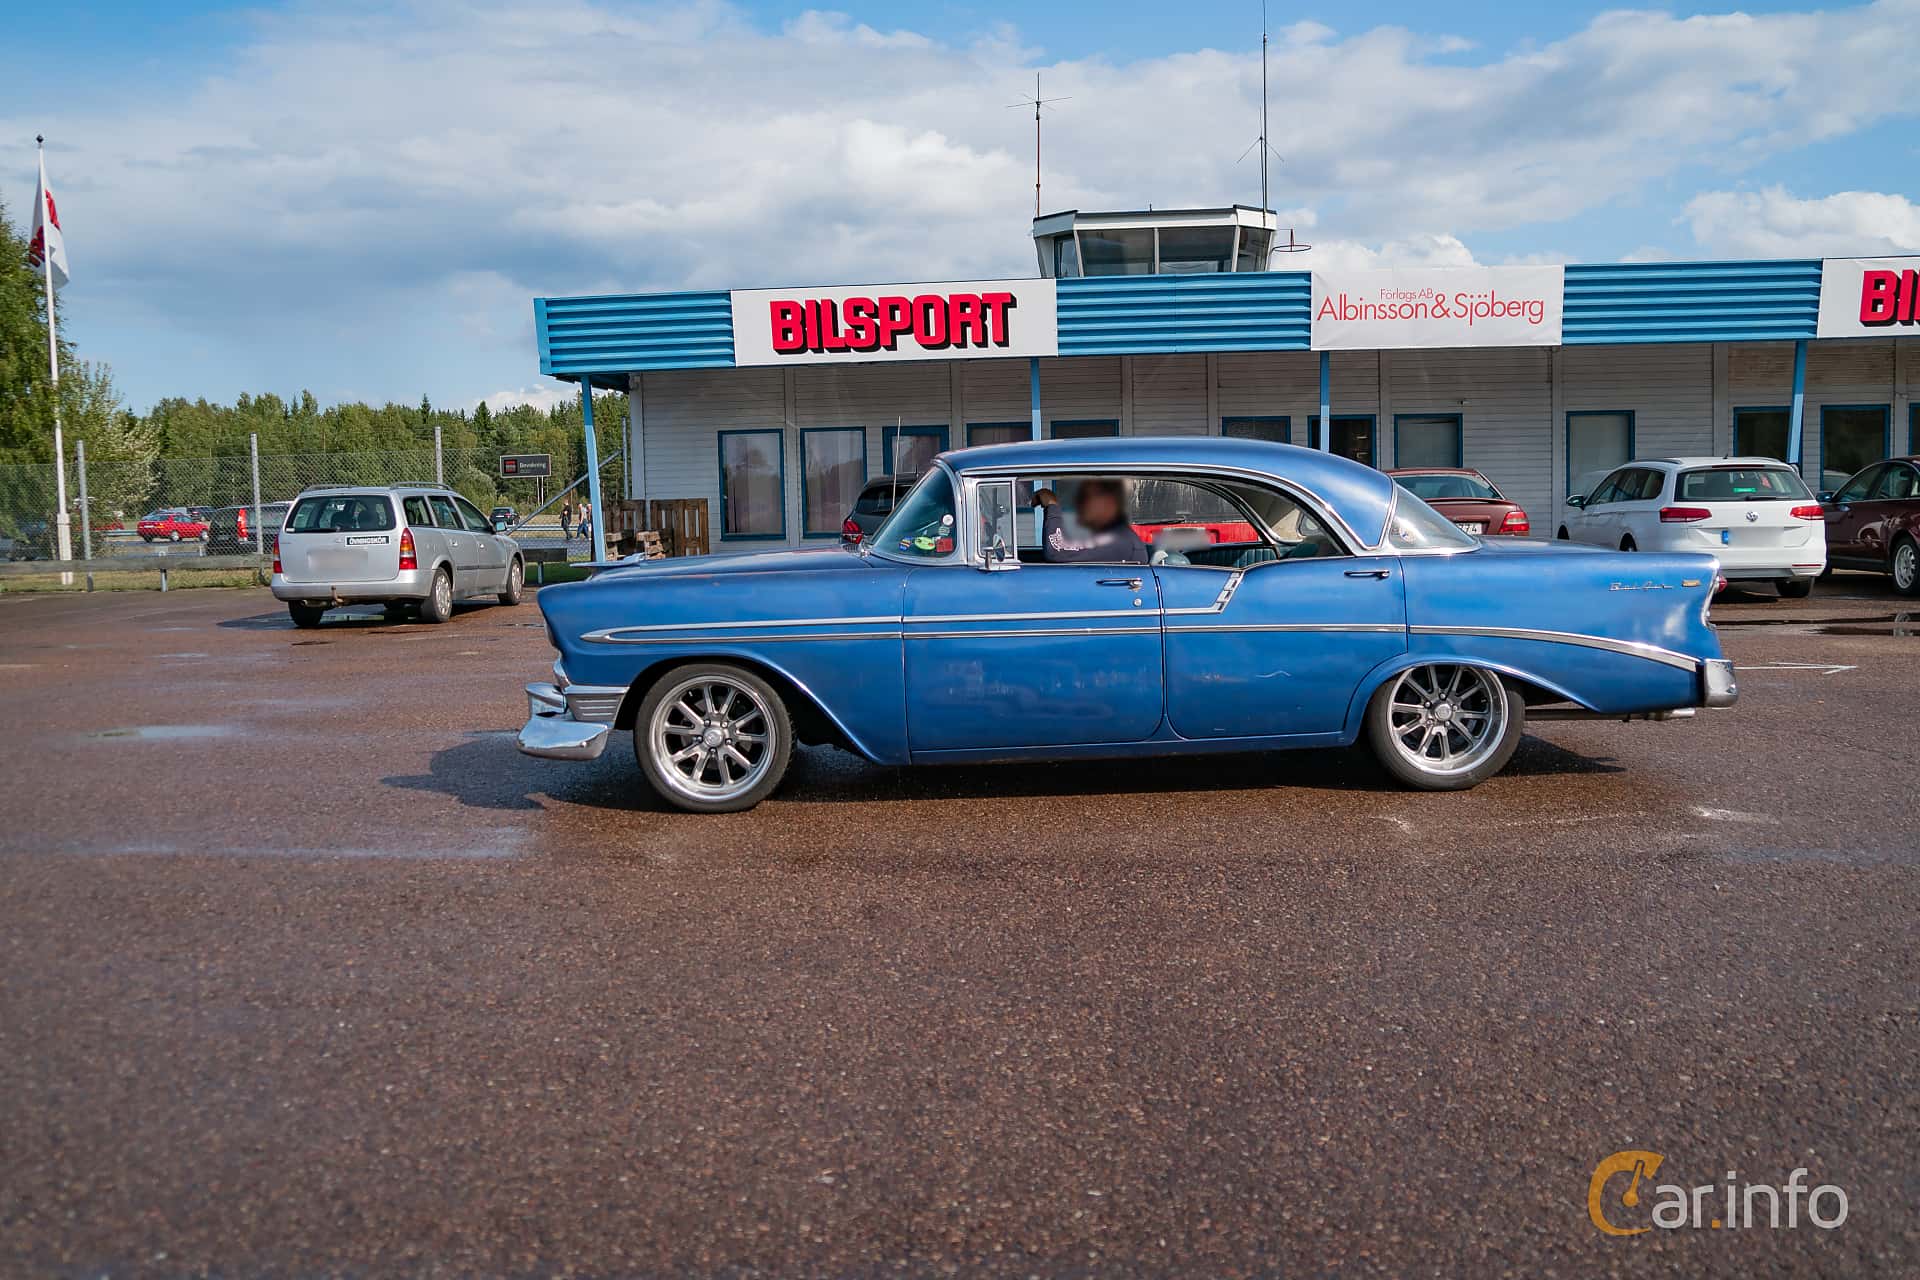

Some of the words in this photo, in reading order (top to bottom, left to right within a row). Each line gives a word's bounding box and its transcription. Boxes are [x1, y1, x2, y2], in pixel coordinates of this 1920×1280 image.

[1317, 293, 1428, 321] Albinsson
[1453, 290, 1545, 326] Sjöberg
[1380, 288, 1416, 302] Förlags
[1418, 288, 1434, 299] AB
[769, 292, 1017, 354] BILSPORT
